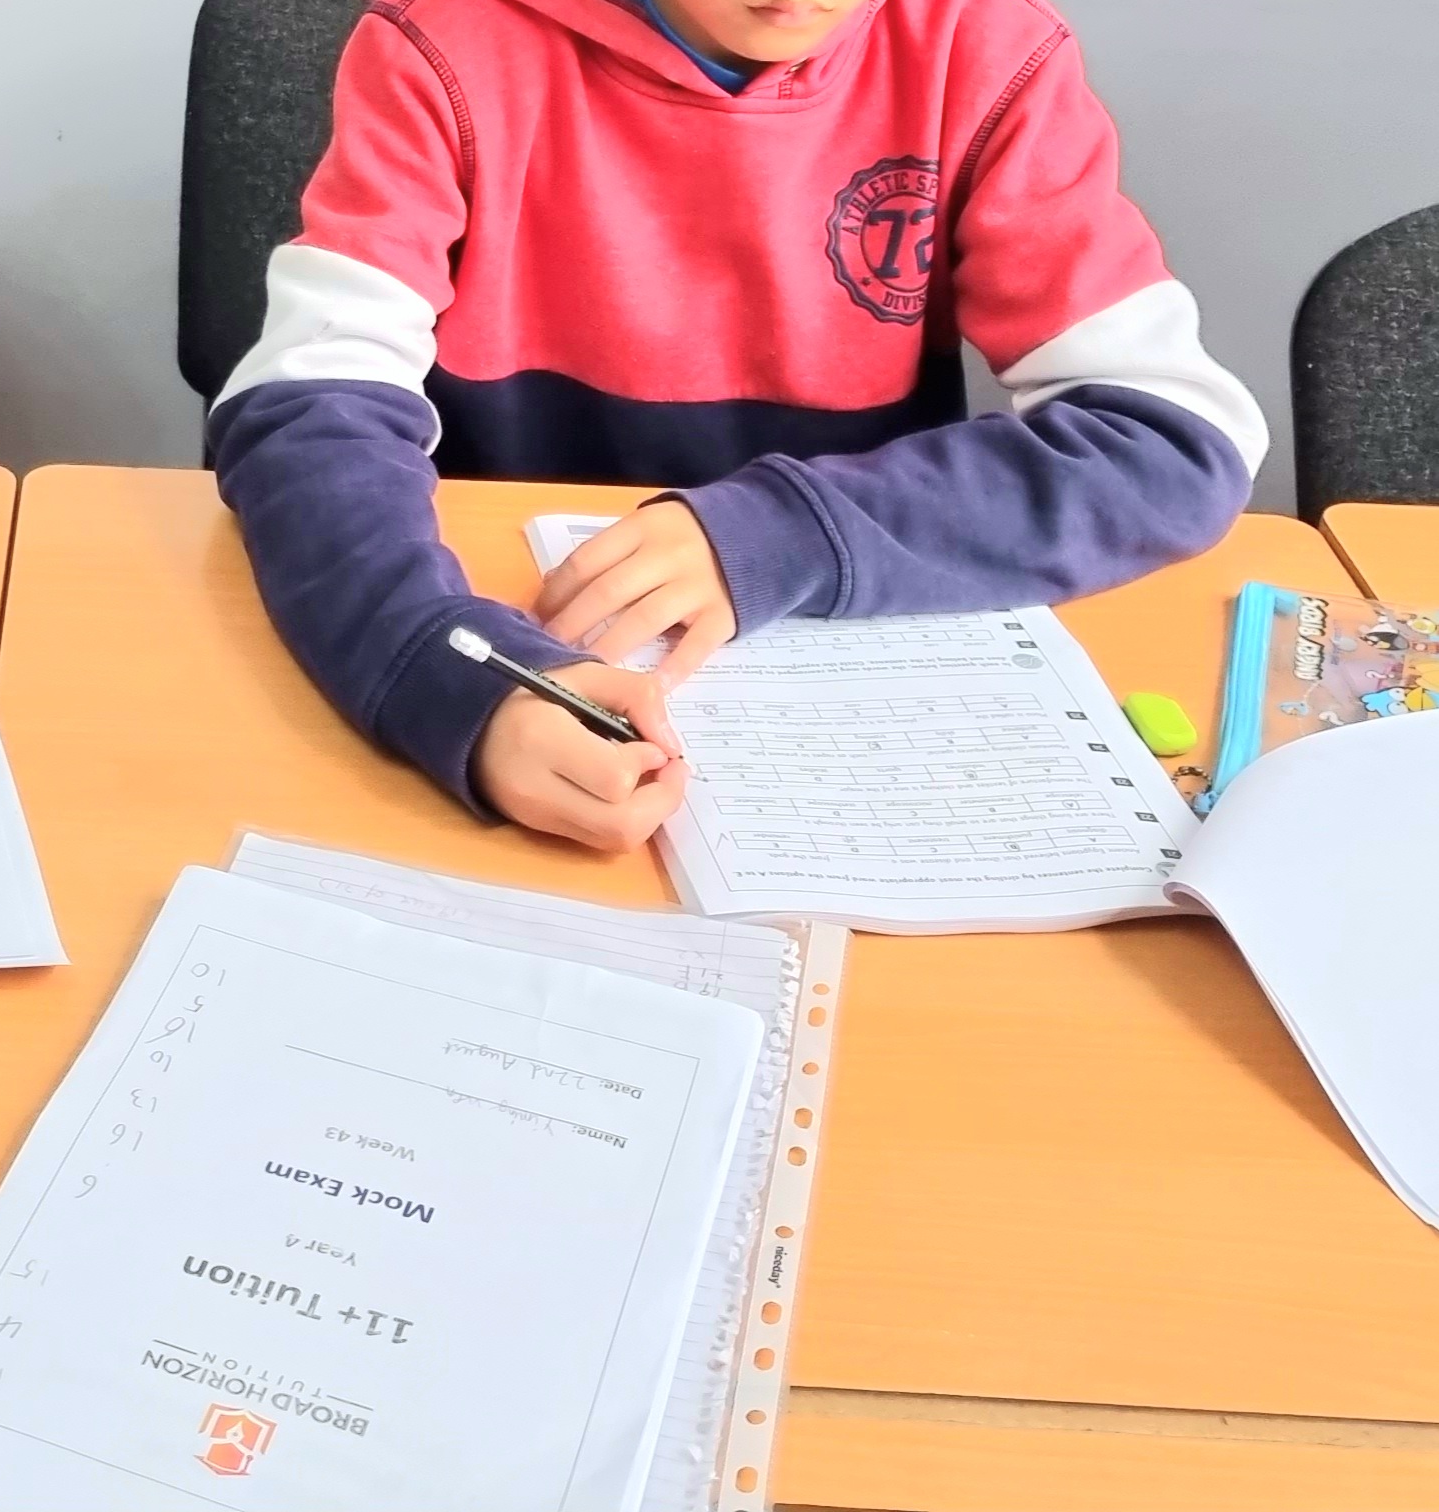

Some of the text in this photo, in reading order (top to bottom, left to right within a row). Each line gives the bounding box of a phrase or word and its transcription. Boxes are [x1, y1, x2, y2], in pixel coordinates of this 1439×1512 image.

[842, 172, 909, 235] ATHLETIC
[1293, 597, 1329, 680] ANGRY BIRDS
[190, 962, 226, 987] 10
[183, 994, 204, 1013] 5
[150, 1050, 171, 1072] 10
[130, 1089, 157, 1114] 13
[599, 1079, 643, 1100] Date:
[111, 1123, 143, 1151] 16
[325, 1126, 415, 1162] Week 43
[571, 1125, 628, 1149] Name:
[75, 1174, 97, 1198] 6
[264, 1161, 434, 1224] Mock Exam
[285, 1233, 358, 1266] Year 4
[183, 1255, 414, 1344] 11+ Tuition
[201, 1351, 324, 1398] TUITION
[142, 1349, 370, 1437] BROAD HORIZON
